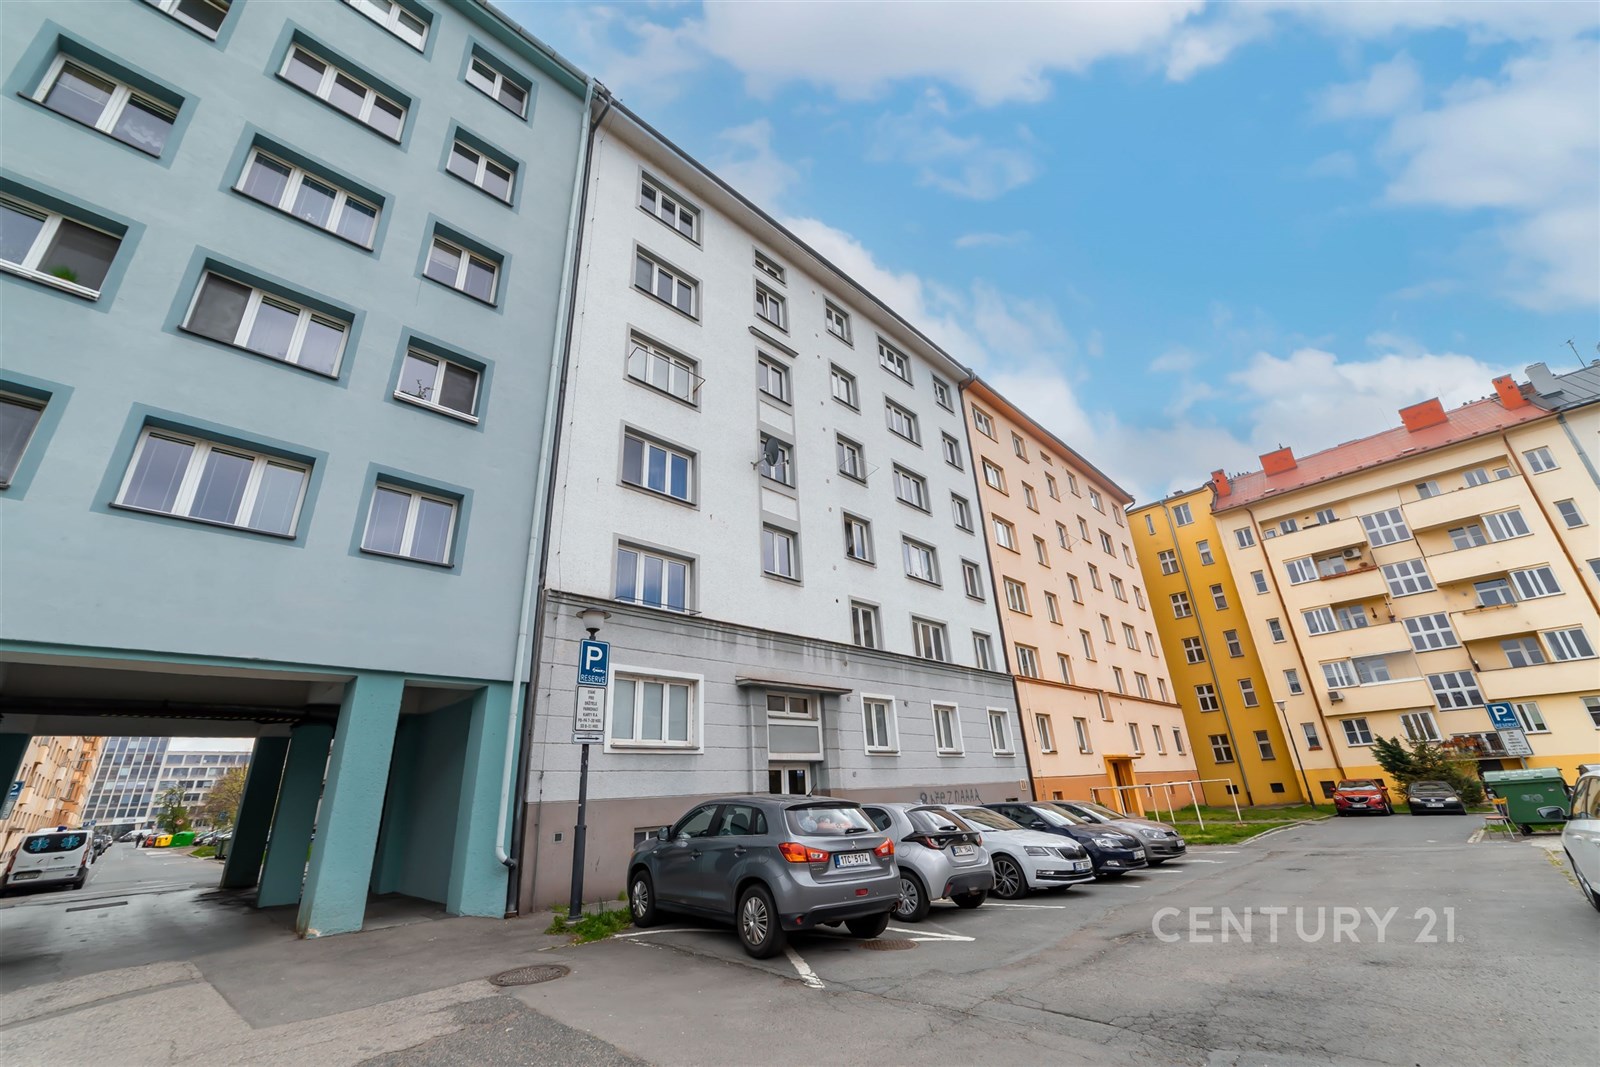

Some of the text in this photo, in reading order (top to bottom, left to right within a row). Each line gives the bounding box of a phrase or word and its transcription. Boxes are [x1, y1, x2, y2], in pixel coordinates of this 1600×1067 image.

[586, 646, 603, 670] P
[1492, 706, 1507, 721] P
[854, 853, 868, 863] 5174
